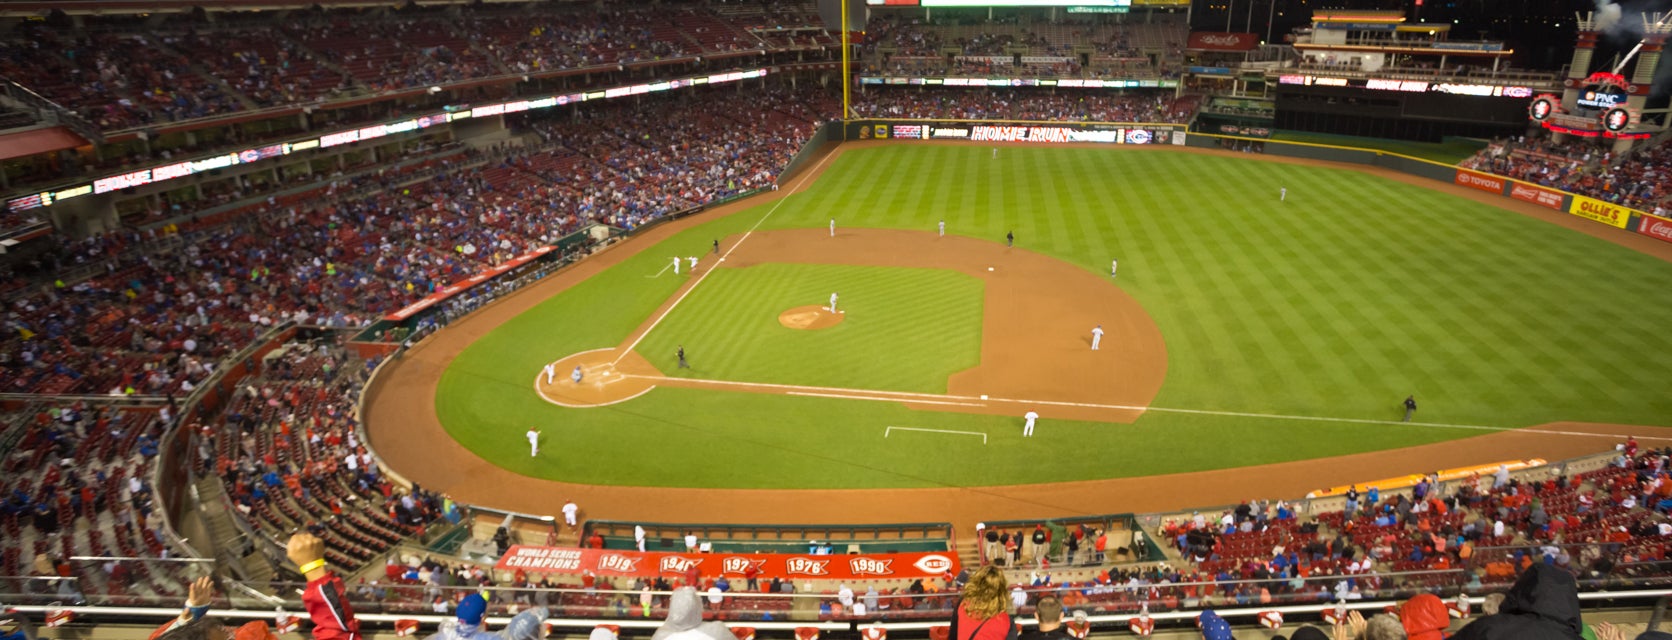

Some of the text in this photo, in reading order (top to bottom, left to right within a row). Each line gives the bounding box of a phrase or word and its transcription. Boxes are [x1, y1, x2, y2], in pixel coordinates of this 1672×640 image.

[1595, 93, 1619, 104] PNC
[971, 126, 1027, 142] HOME
[1029, 127, 1071, 142] RUN
[1470, 176, 1501, 189] TOYOTA
[1580, 201, 1620, 219] OLLIE'S
[517, 548, 582, 559] WORLD SERIES
[505, 556, 581, 570] CHAMPIONS
[602, 556, 631, 571] 1919
[727, 558, 755, 572] 197
[789, 560, 821, 574] 1976
[853, 560, 884, 574] 1990
